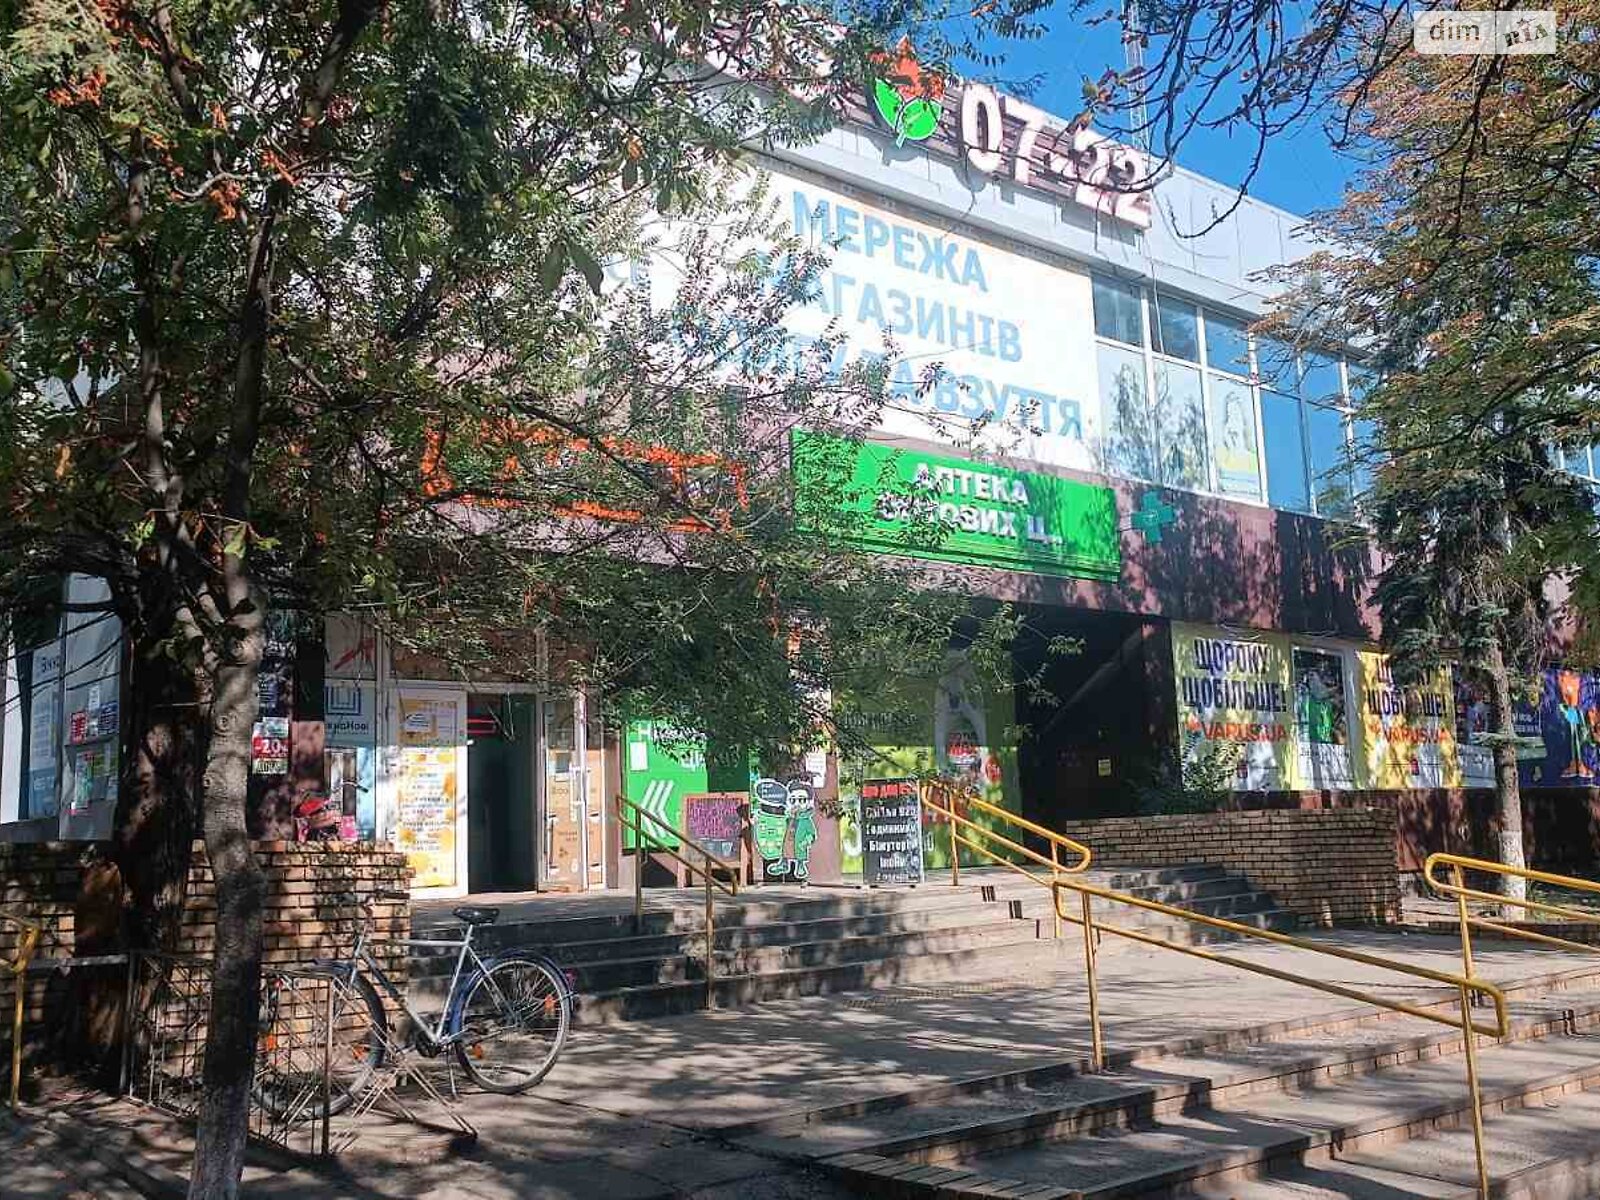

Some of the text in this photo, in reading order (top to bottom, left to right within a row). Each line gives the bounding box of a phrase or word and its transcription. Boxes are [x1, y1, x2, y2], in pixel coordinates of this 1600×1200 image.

[792, 190, 989, 293] МЕРЕЖА
[936, 366, 1084, 441] ВЗУТТЯ
[912, 462, 1029, 506] АПТЕКА
[877, 491, 1018, 538] ООВИХ
[1182, 678, 1287, 713] ЩОБІЛЬШЕ!
[1366, 689, 1448, 718] ЩОБІШЕ!
